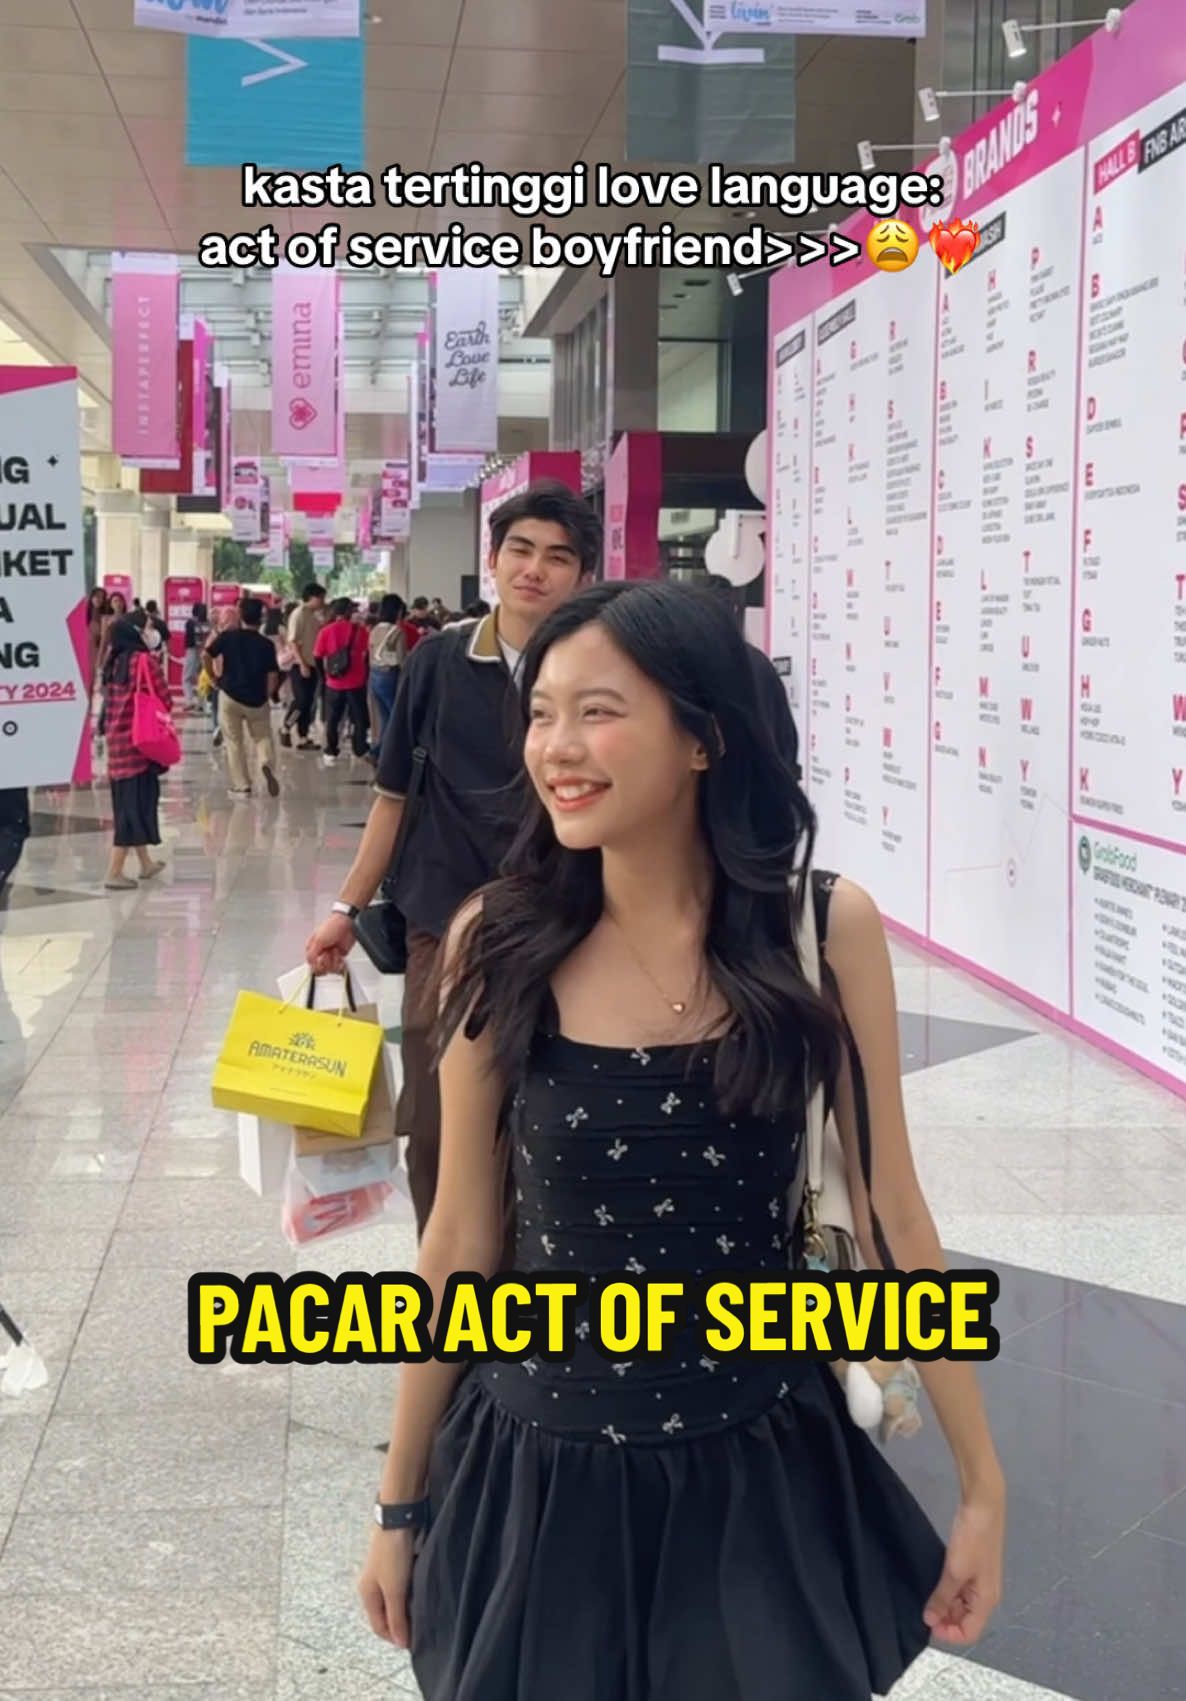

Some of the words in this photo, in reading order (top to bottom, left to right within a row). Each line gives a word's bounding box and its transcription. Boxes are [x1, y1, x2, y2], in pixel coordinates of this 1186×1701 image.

[963, 89, 1039, 200] BRANDS
[1144, 128, 1168, 164] FNB
[1098, 147, 1127, 187] HALL
[1127, 140, 1137, 164] B
[292, 301, 312, 389] emina
[444, 320, 491, 350] Earth
[444, 350, 491, 369] Love
[448, 367, 486, 389] Life
[0, 455, 29, 484] G
[0, 548, 74, 577] KET
[23, 681, 76, 699] 2024
[248, 1040, 347, 1078] AMATERASUN
